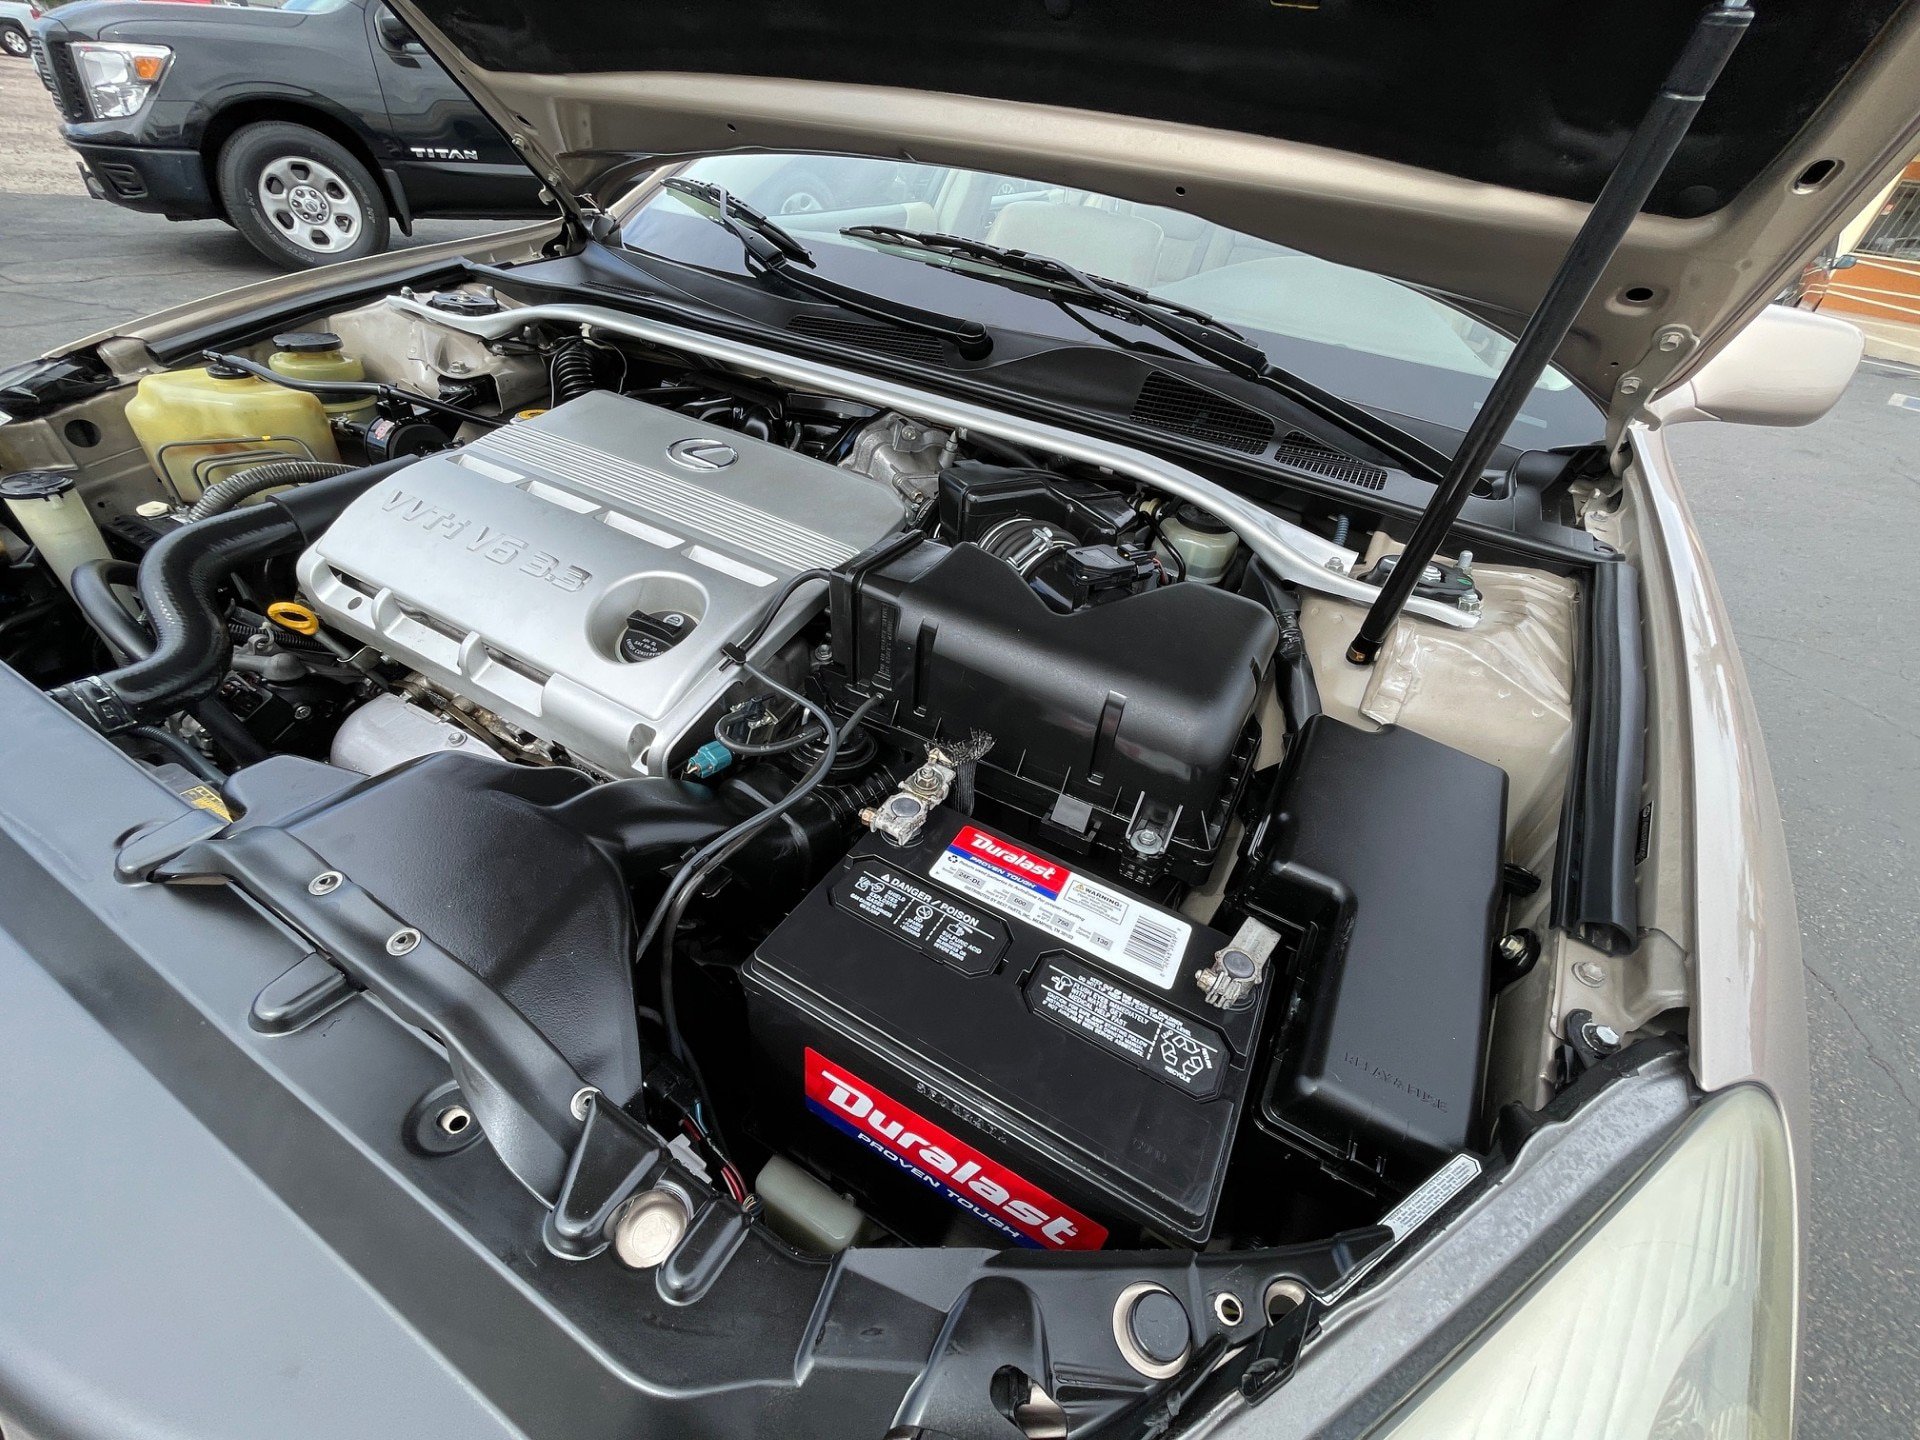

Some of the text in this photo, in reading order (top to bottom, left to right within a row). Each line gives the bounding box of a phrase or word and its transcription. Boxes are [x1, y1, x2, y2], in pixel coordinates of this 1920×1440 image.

[410, 147, 478, 160] TITAN
[466, 526, 529, 564] V6
[519, 551, 593, 592] 3.3
[970, 856, 1005, 875] PROVEN
[1006, 872, 1036, 889] TOUGH
[971, 833, 1056, 880] Duralast
[890, 877, 979, 926] DANGER / POISON
[1013, 897, 1026, 906] 600
[941, 930, 981, 954] SULFURIC ACID
[1068, 993, 1127, 1027] MEDICAL HELP FAST
[1070, 987, 1087, 998] WITH
[1109, 1008, 1122, 1017] GET
[1072, 982, 1148, 1025] FLUSH EYES IMMEDIATELY
[1164, 1065, 1191, 1083] RECYCLE
[821, 1070, 1077, 1245] Duralast
[857, 1132, 1020, 1239] PROVEN TOUGH
